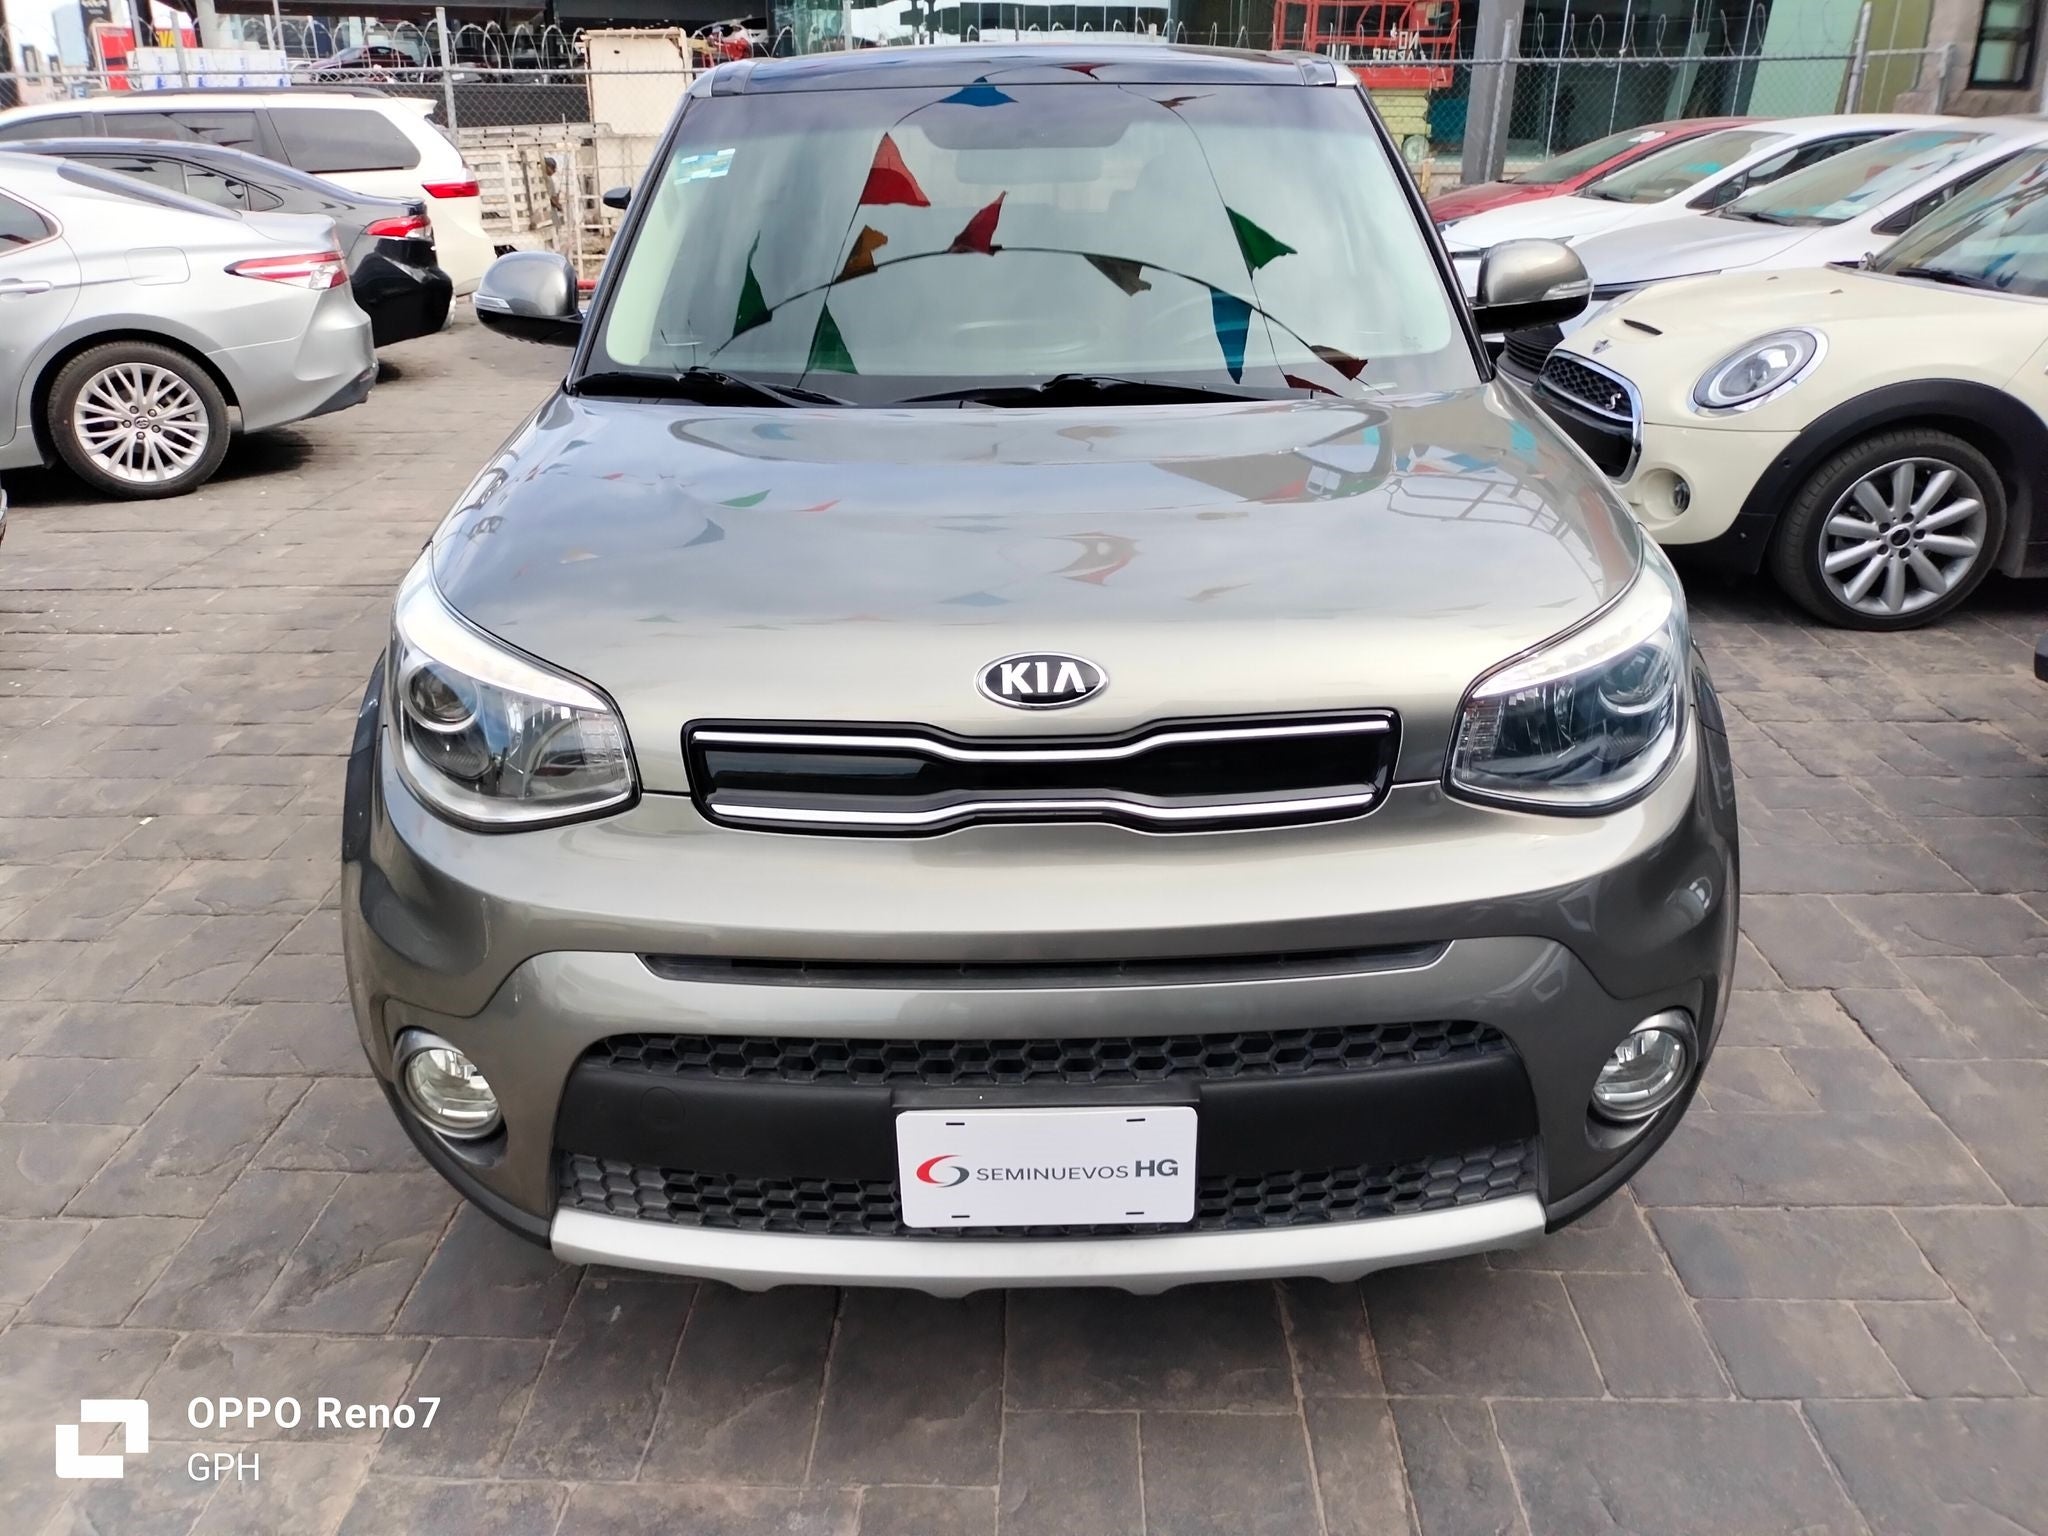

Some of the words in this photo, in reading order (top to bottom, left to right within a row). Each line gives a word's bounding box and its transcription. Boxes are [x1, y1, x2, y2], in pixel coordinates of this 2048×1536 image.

[1000, 661, 1087, 695] KIA
[976, 1165, 1129, 1181] SEMINUEVOS
[1135, 1159, 1179, 1178] HG
